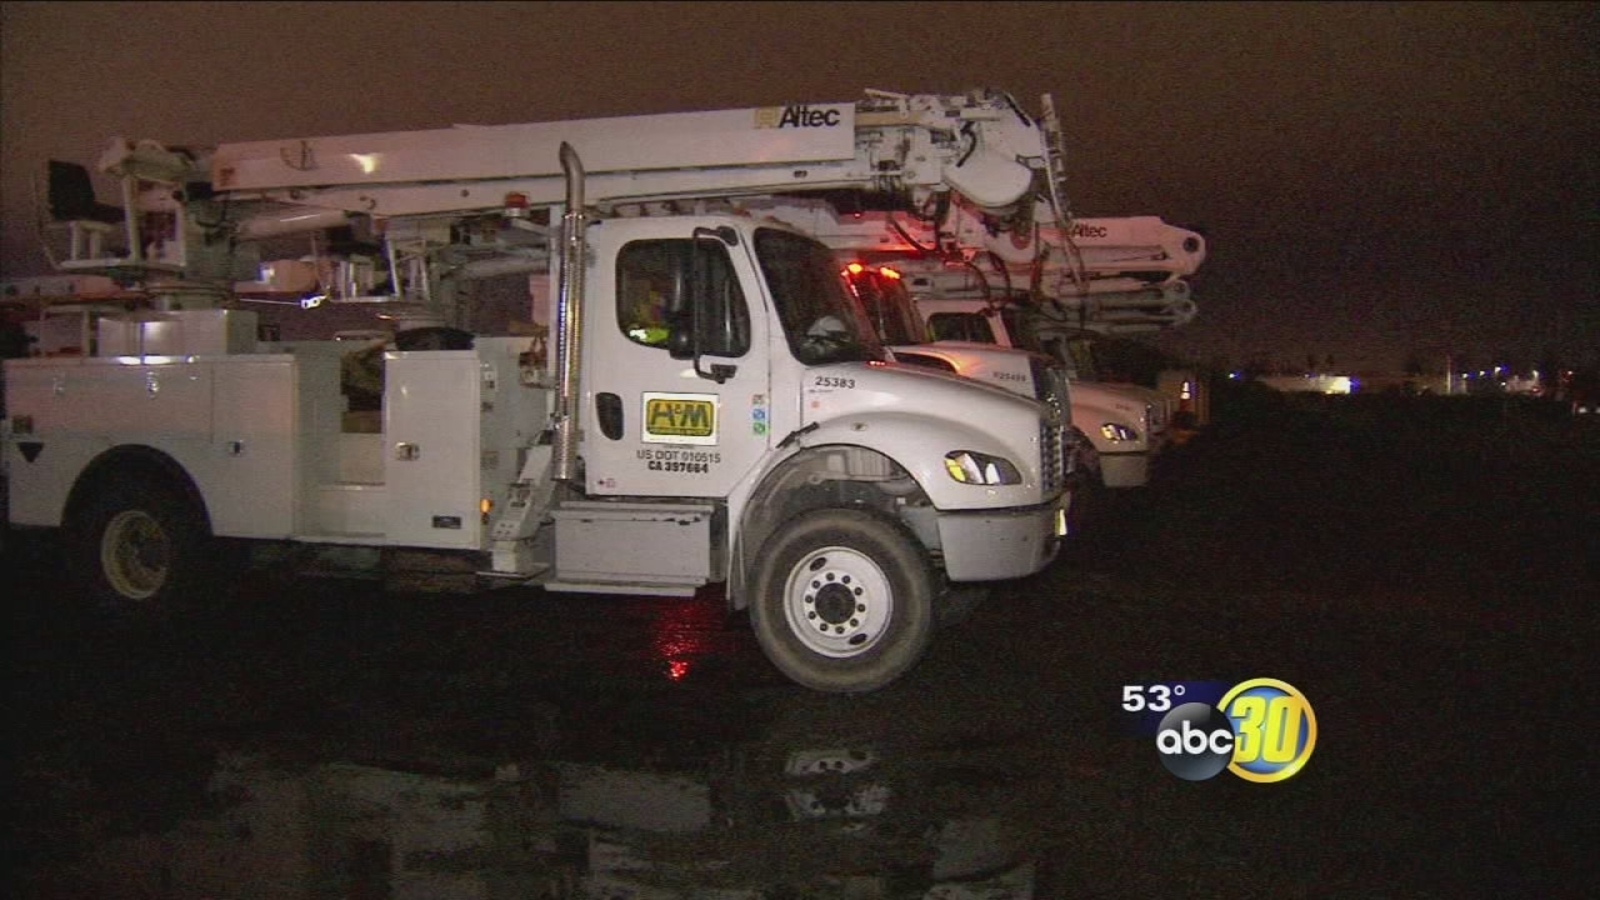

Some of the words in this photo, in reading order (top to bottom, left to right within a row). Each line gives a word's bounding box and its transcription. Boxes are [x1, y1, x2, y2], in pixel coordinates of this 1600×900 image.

[779, 104, 840, 128] Altec
[1070, 223, 1107, 238] Altec
[815, 376, 856, 389] 25383
[636, 449, 653, 460] US
[654, 450, 680, 461] DOT
[648, 460, 662, 471] CA
